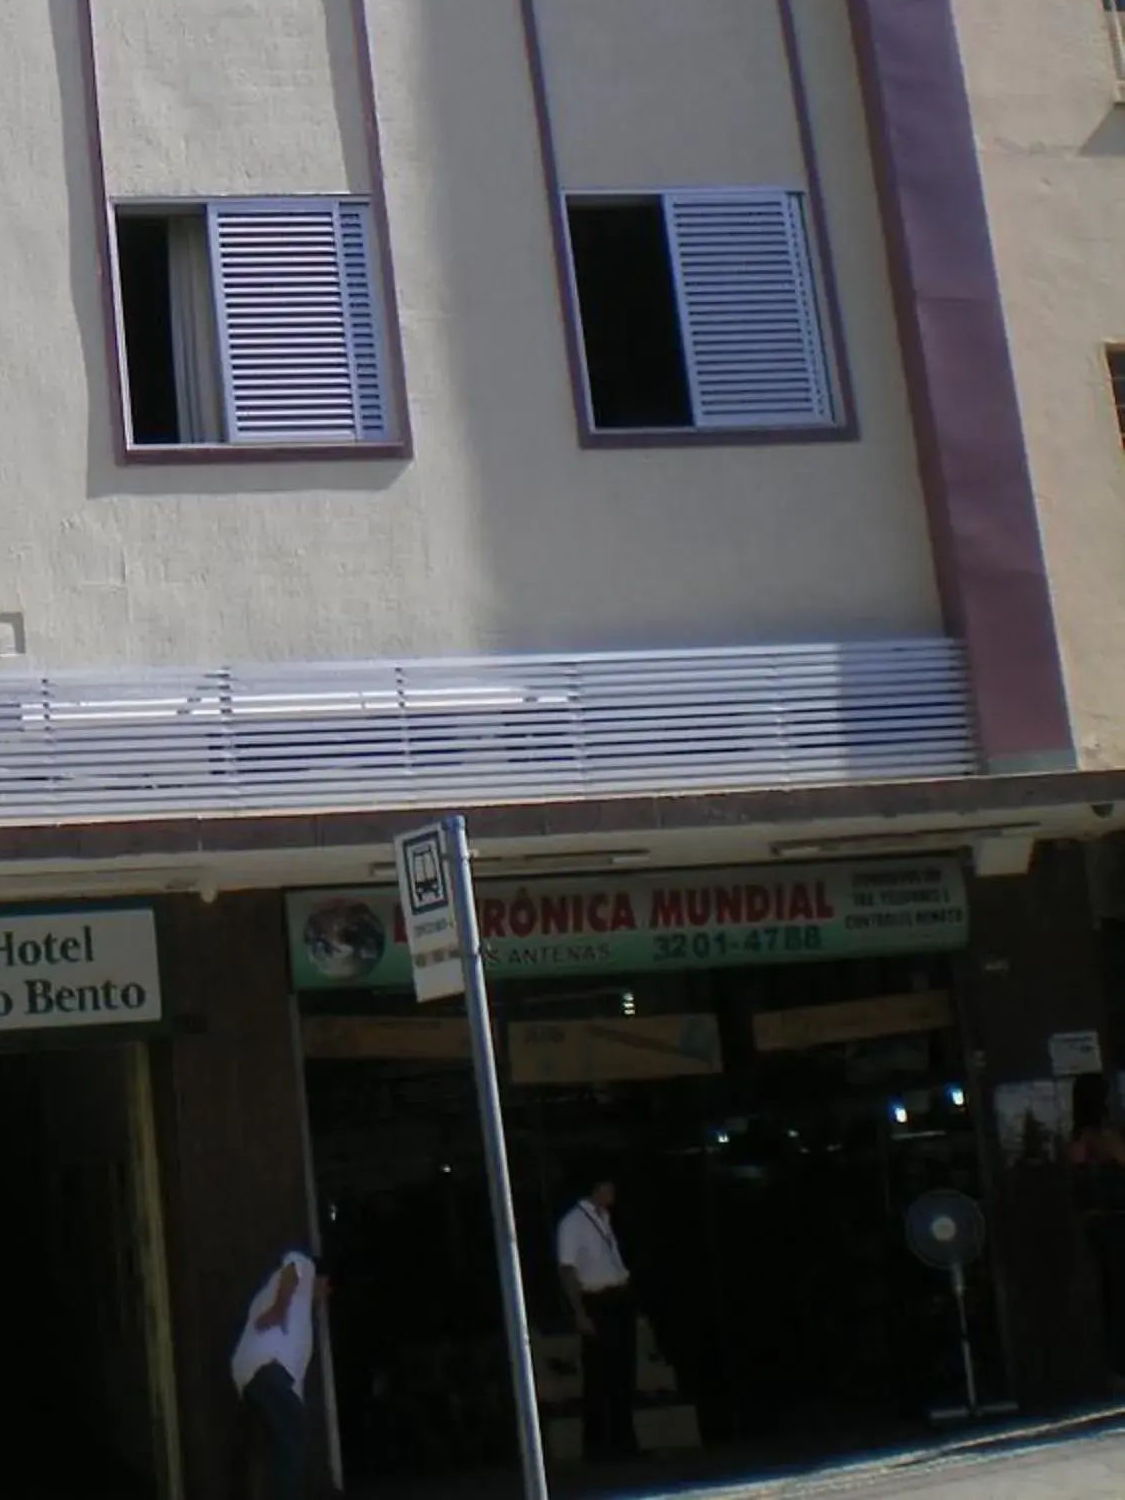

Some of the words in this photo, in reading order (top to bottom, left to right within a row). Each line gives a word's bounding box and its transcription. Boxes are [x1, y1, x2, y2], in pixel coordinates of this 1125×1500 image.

[393, 886, 637, 944] RÔNICA
[650, 881, 835, 929] MUNDIAL
[508, 942, 611, 964] ANTENAS
[653, 925, 823, 962] 3201-4788
[24, 979, 146, 1015] Bento
